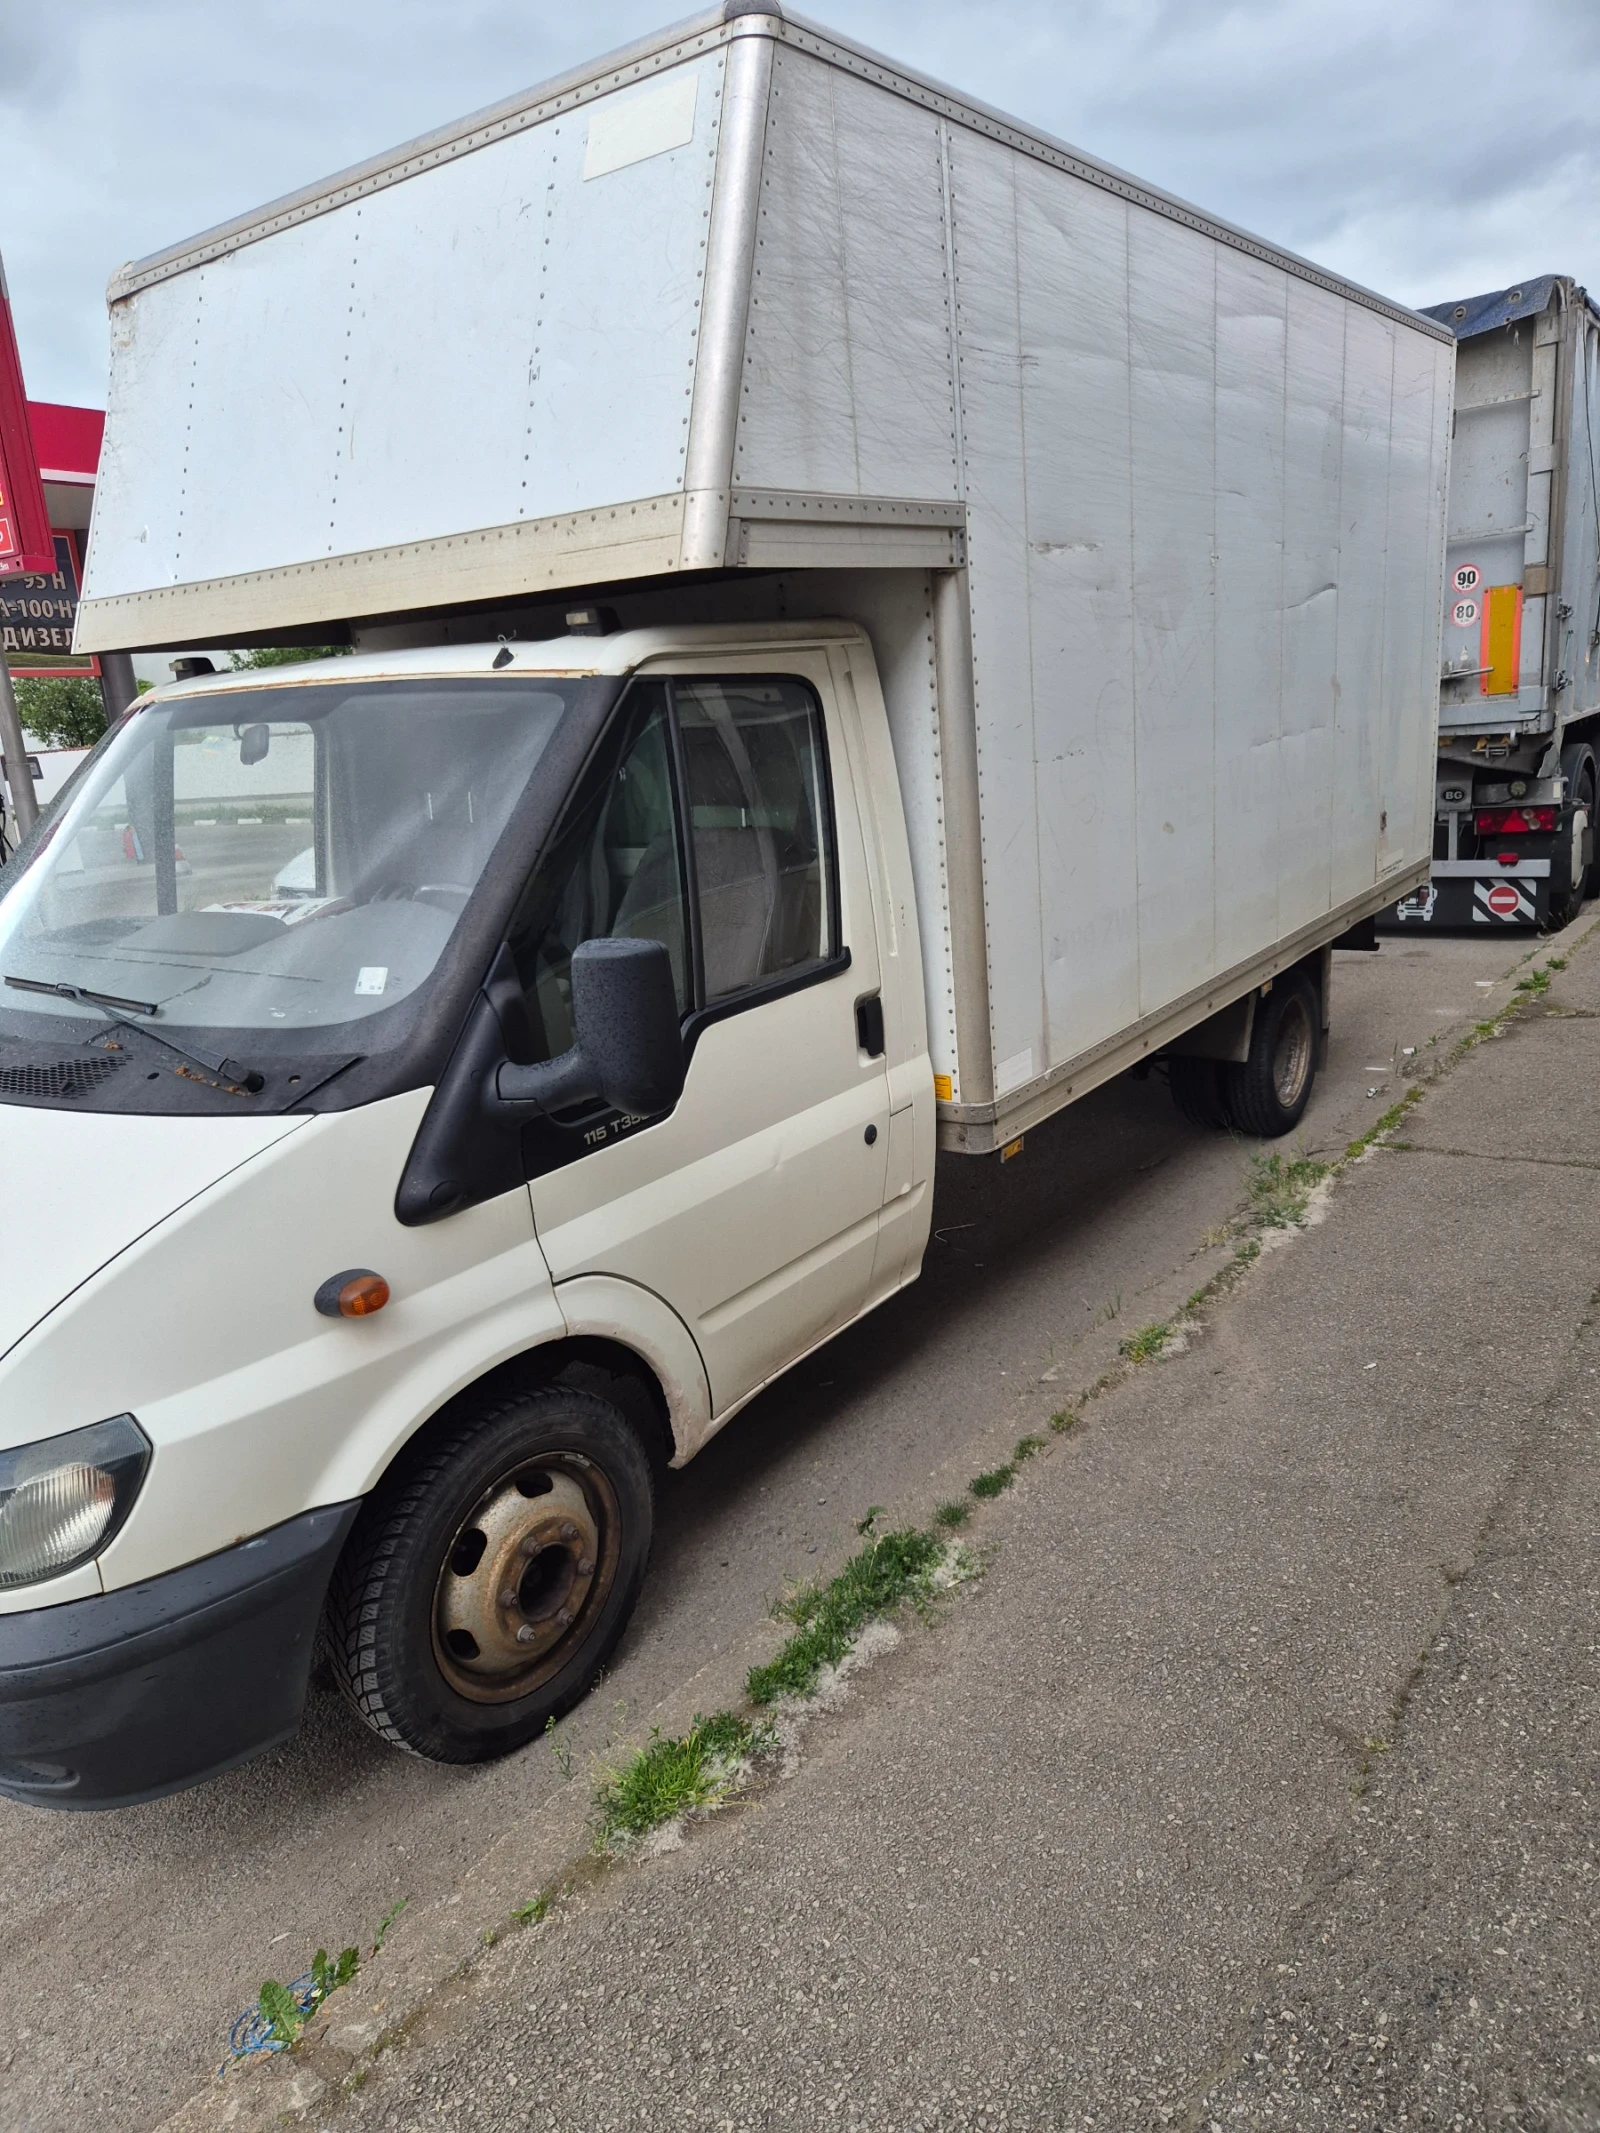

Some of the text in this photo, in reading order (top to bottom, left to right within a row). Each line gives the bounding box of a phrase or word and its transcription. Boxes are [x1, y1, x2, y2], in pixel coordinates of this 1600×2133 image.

[1457, 570, 1476, 586] 90
[1456, 604, 1475, 618] 80
[1445, 791, 1463, 800] BG
[583, 1113, 650, 1145] 115 T35
